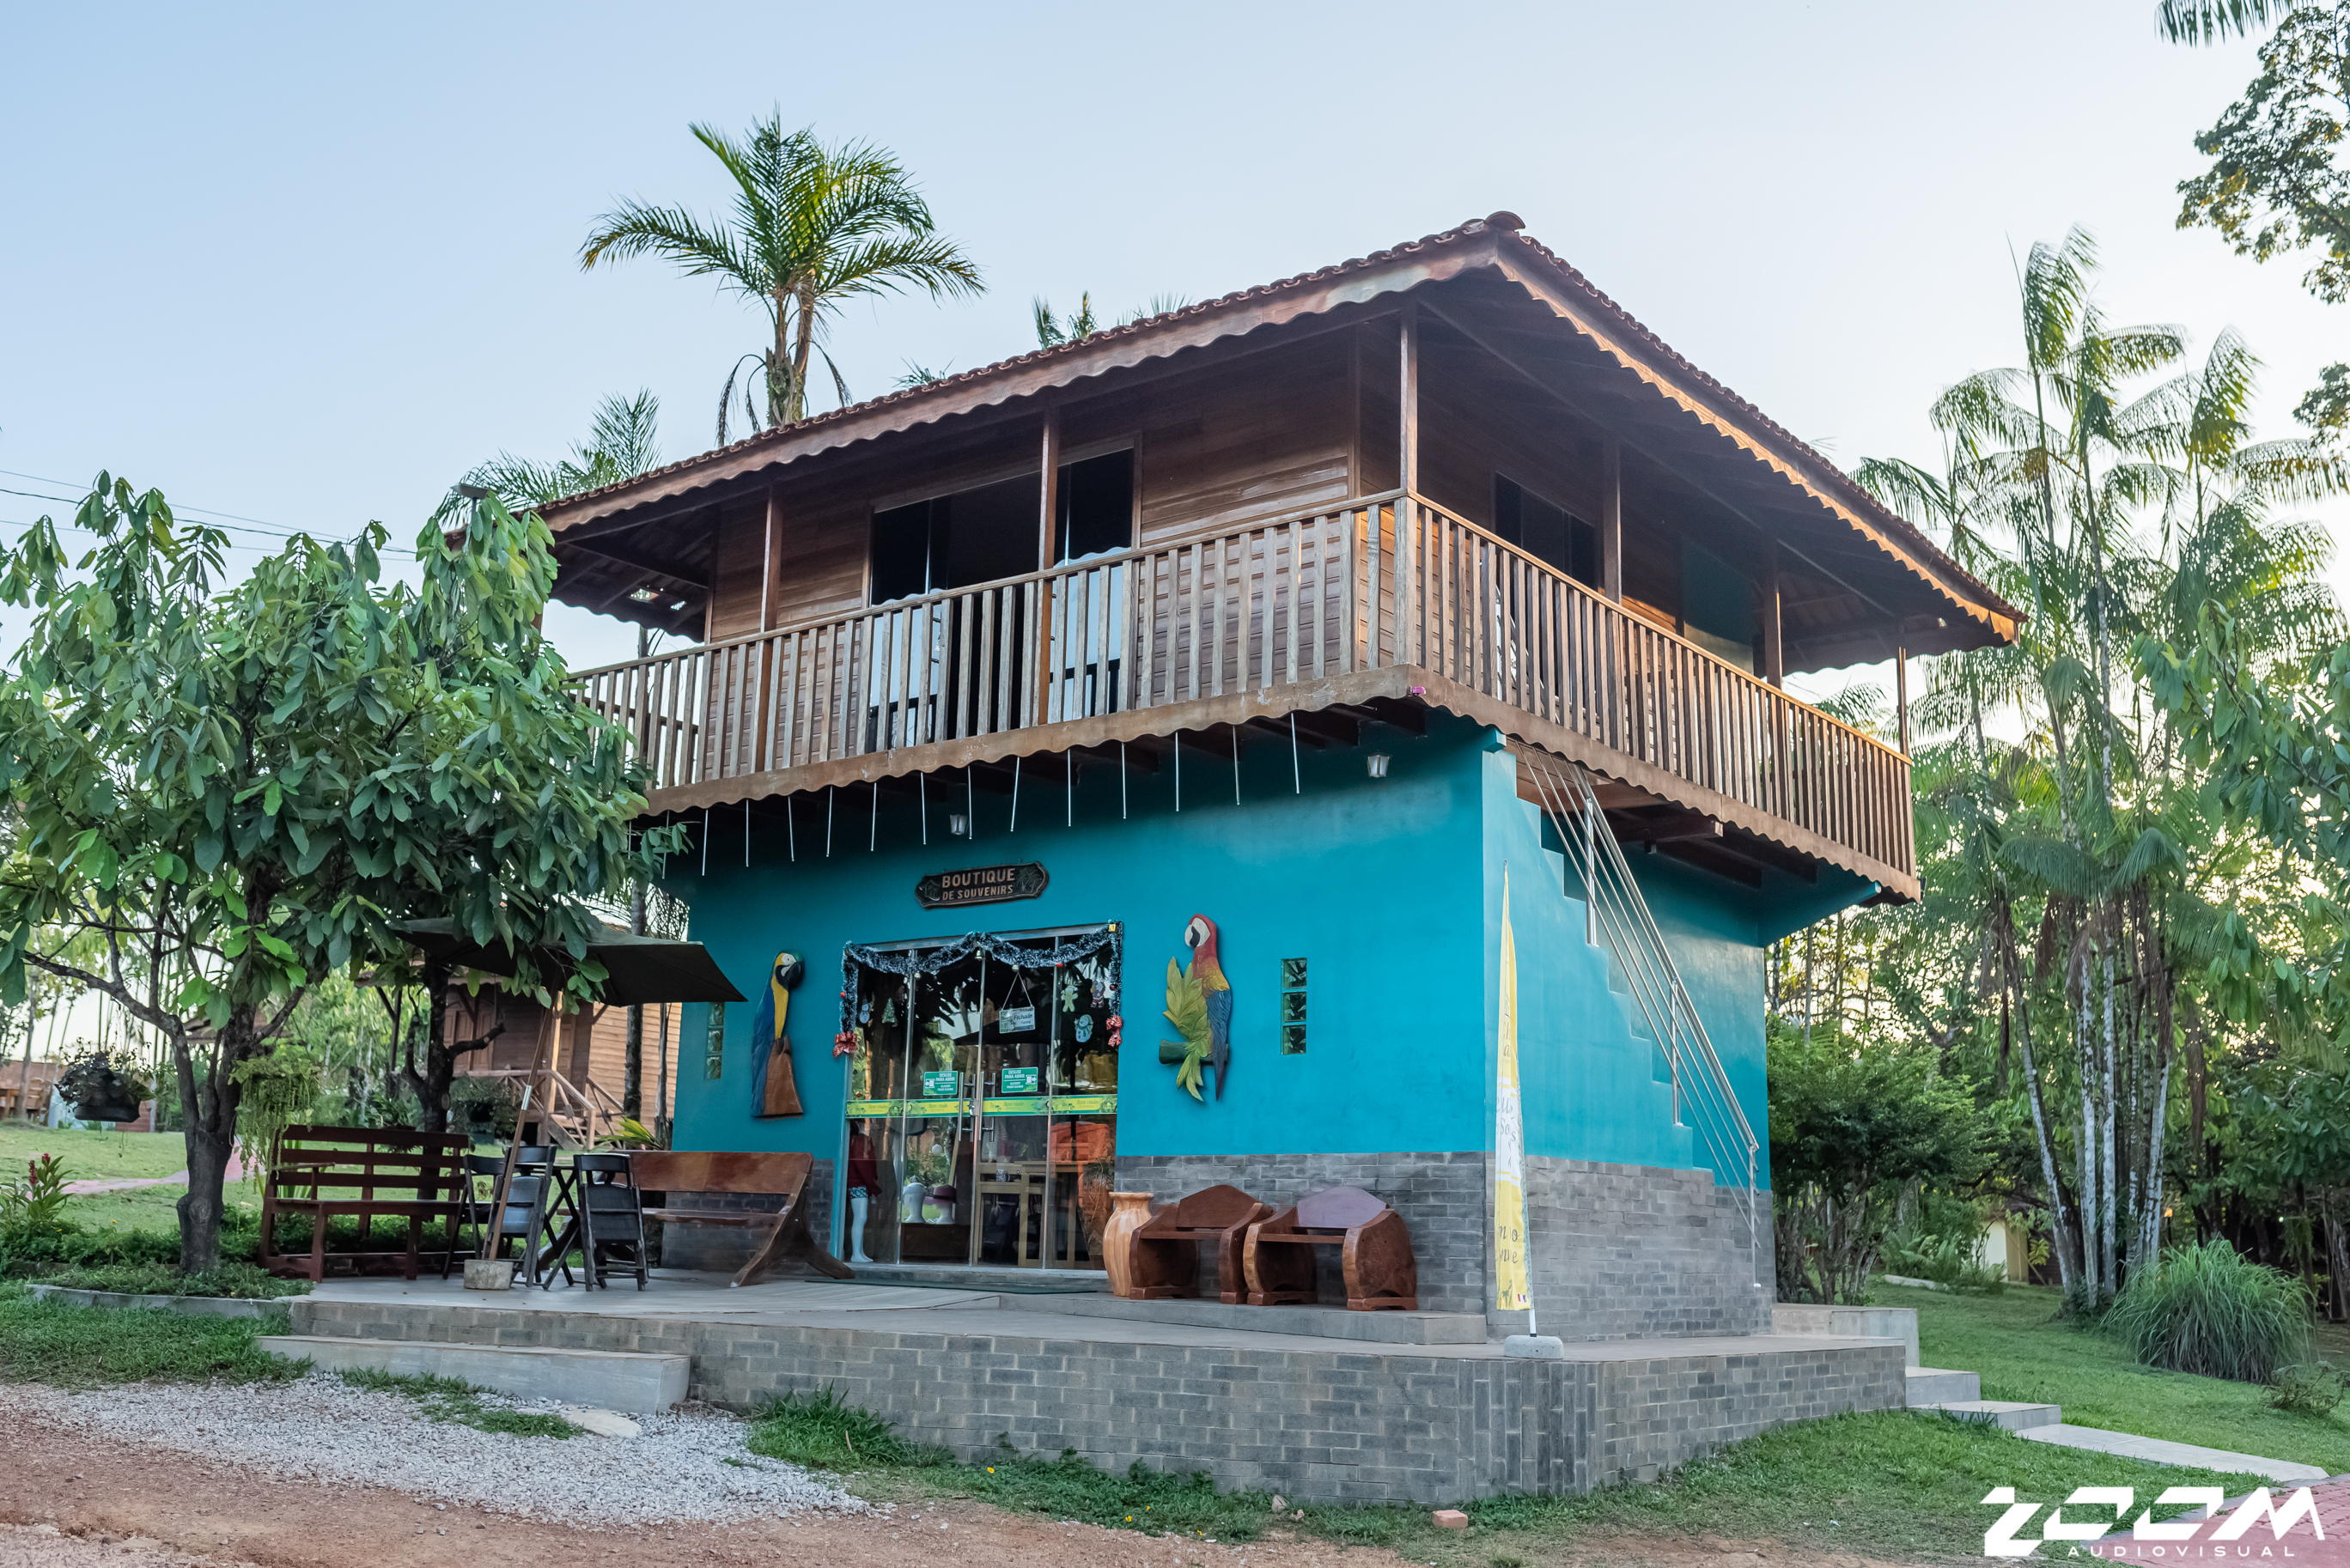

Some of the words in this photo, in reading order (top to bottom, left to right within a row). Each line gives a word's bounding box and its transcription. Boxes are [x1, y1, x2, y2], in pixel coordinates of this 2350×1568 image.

[942, 868, 1015, 888] BOUTIQUE
[942, 890, 954, 901] DE
[957, 884, 1014, 899] SOUVENIRS
